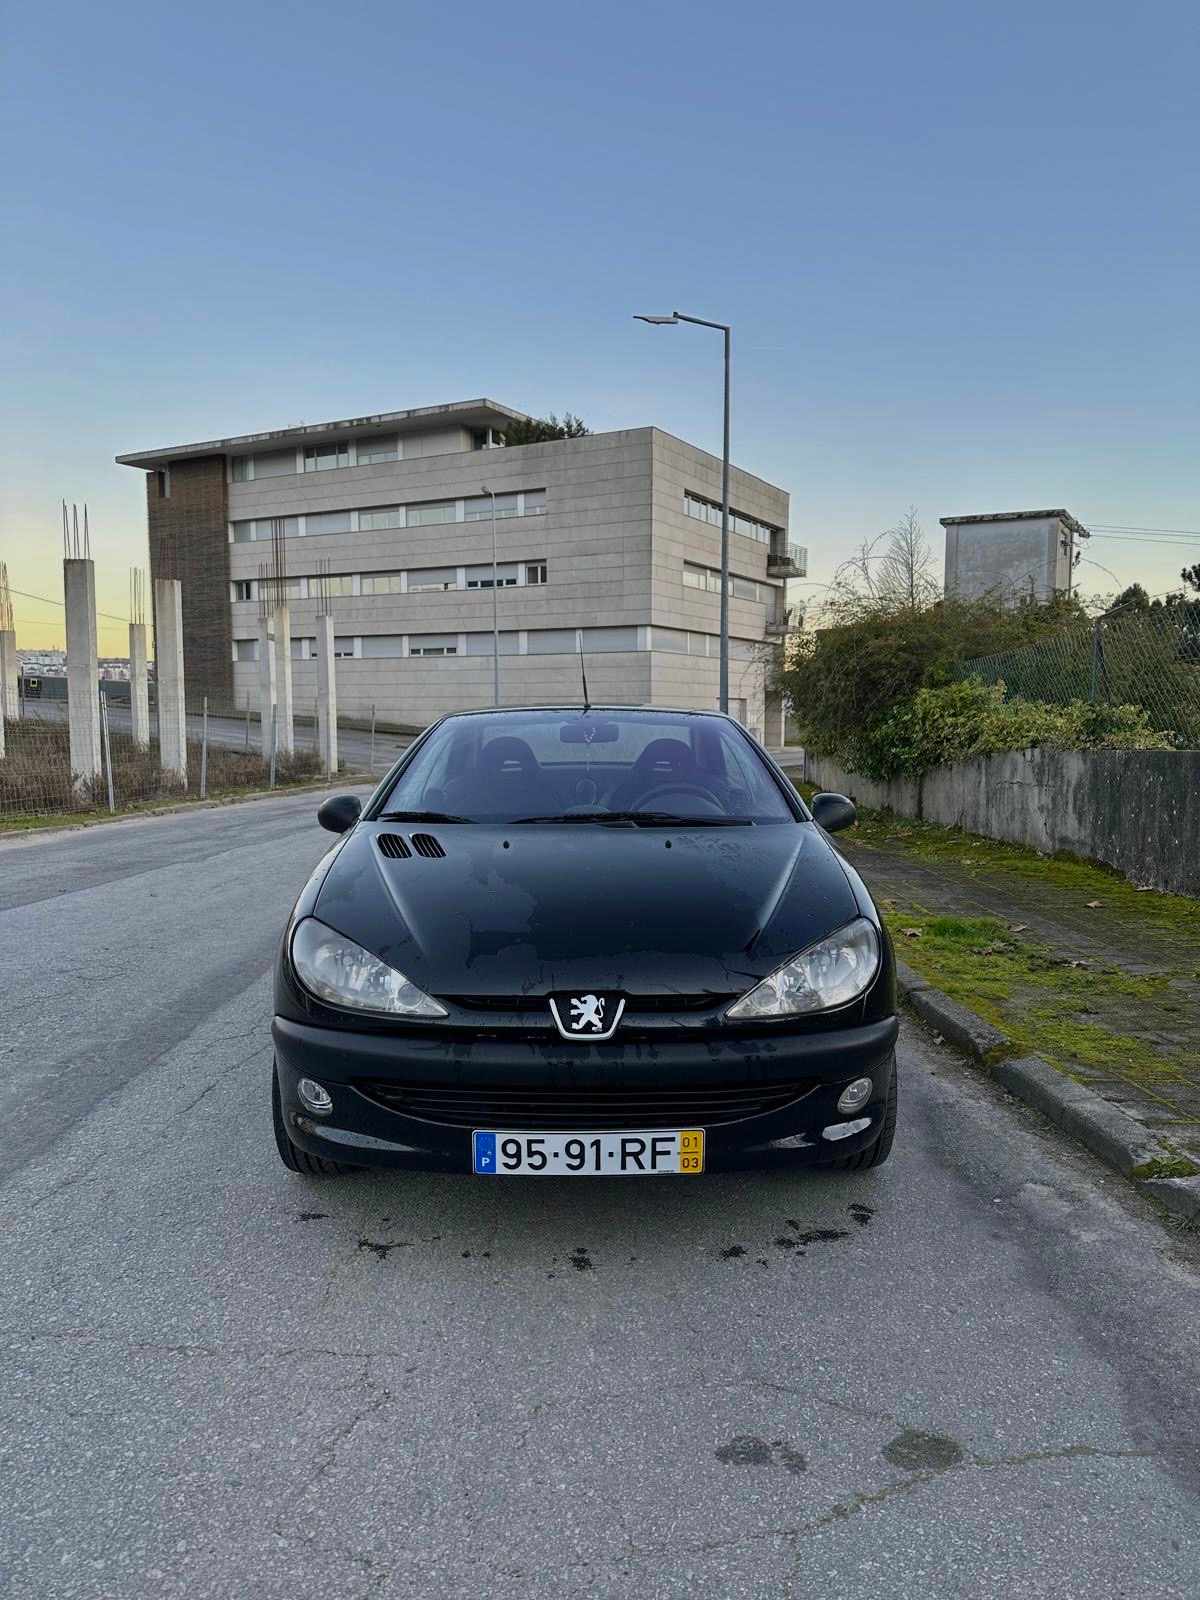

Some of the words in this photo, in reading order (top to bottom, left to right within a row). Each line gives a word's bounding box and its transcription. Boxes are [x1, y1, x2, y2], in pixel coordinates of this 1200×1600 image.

[682, 1136, 698, 1148] 01
[481, 1157, 490, 1167] P
[682, 1157, 699, 1169] 03
